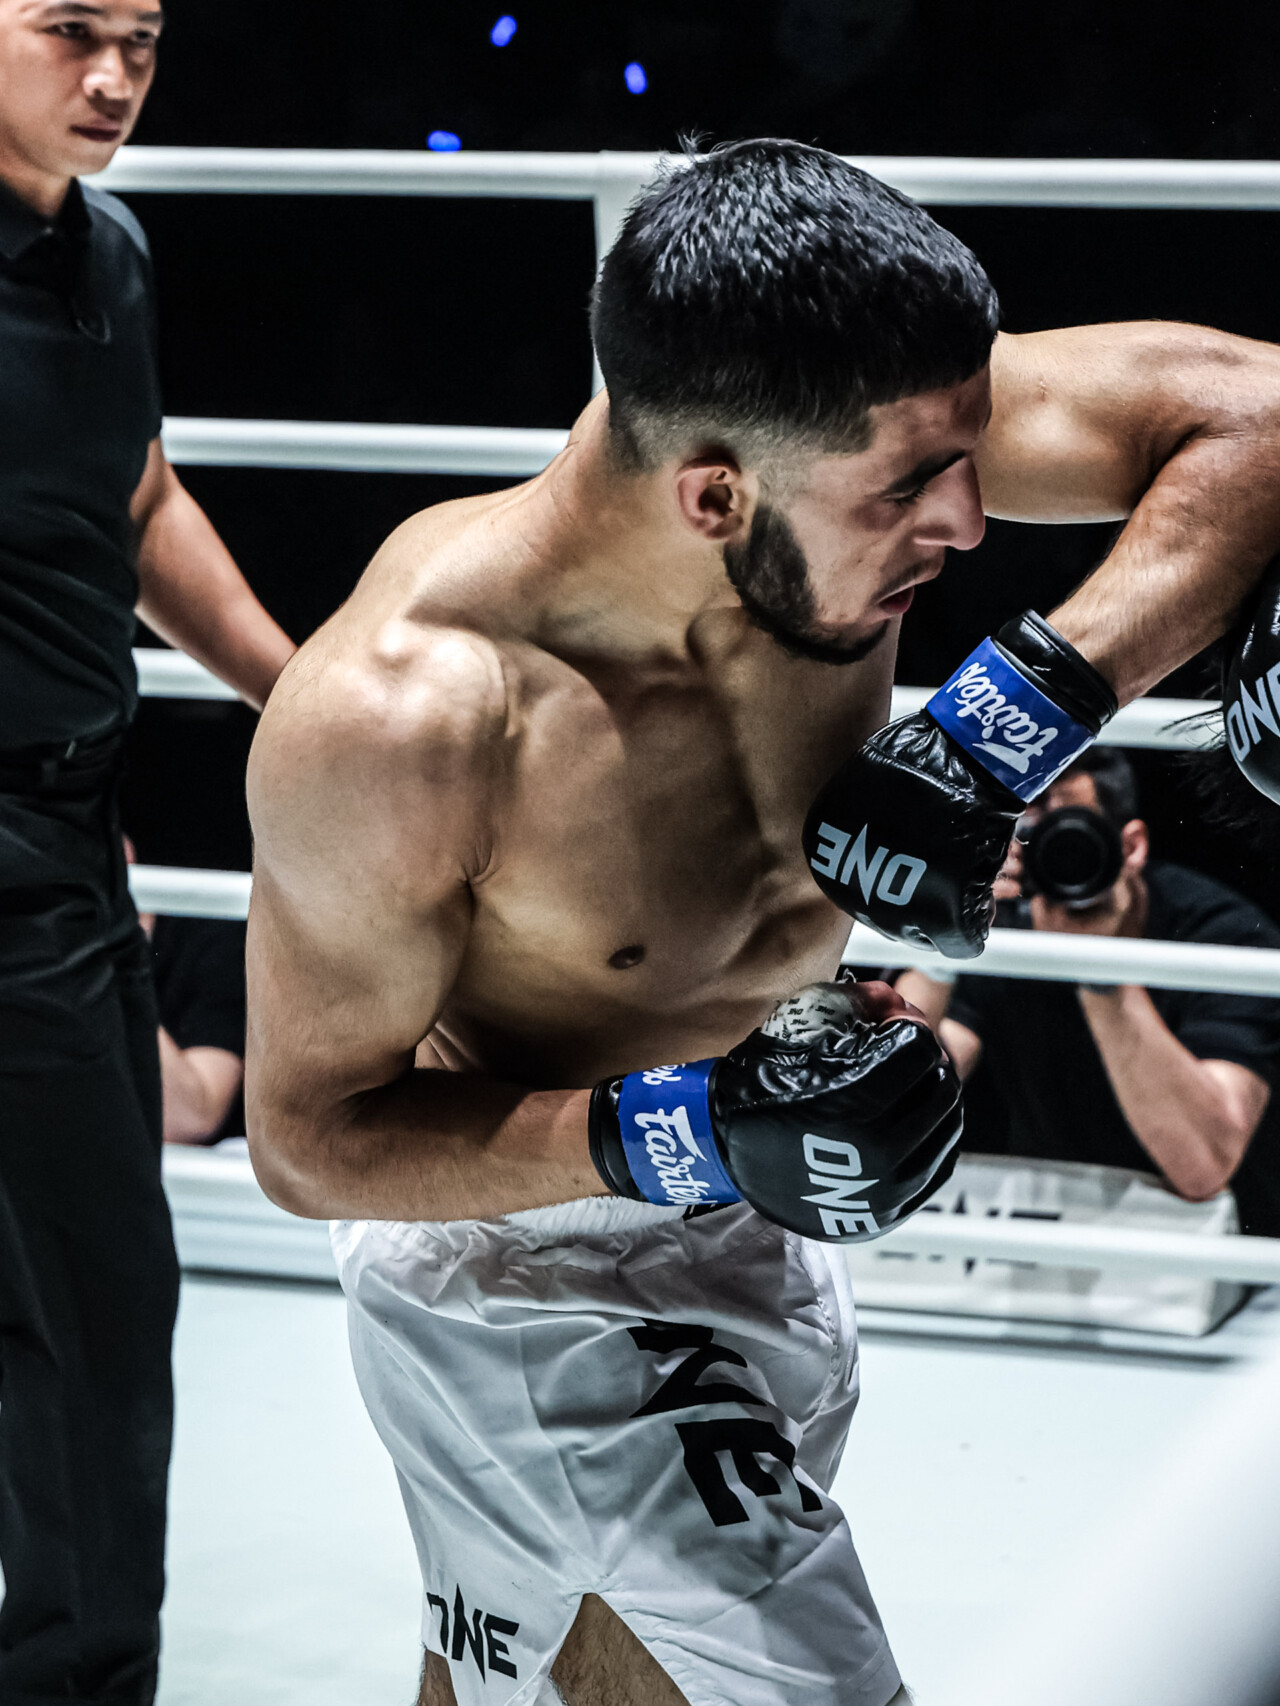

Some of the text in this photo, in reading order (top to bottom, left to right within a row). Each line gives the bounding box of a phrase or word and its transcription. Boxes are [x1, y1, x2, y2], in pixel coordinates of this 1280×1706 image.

[946, 662, 1058, 774] Fairtex
[811, 821, 927, 906] ONE
[800, 1133, 880, 1237] ONE
[626, 1317, 823, 1527] NE
